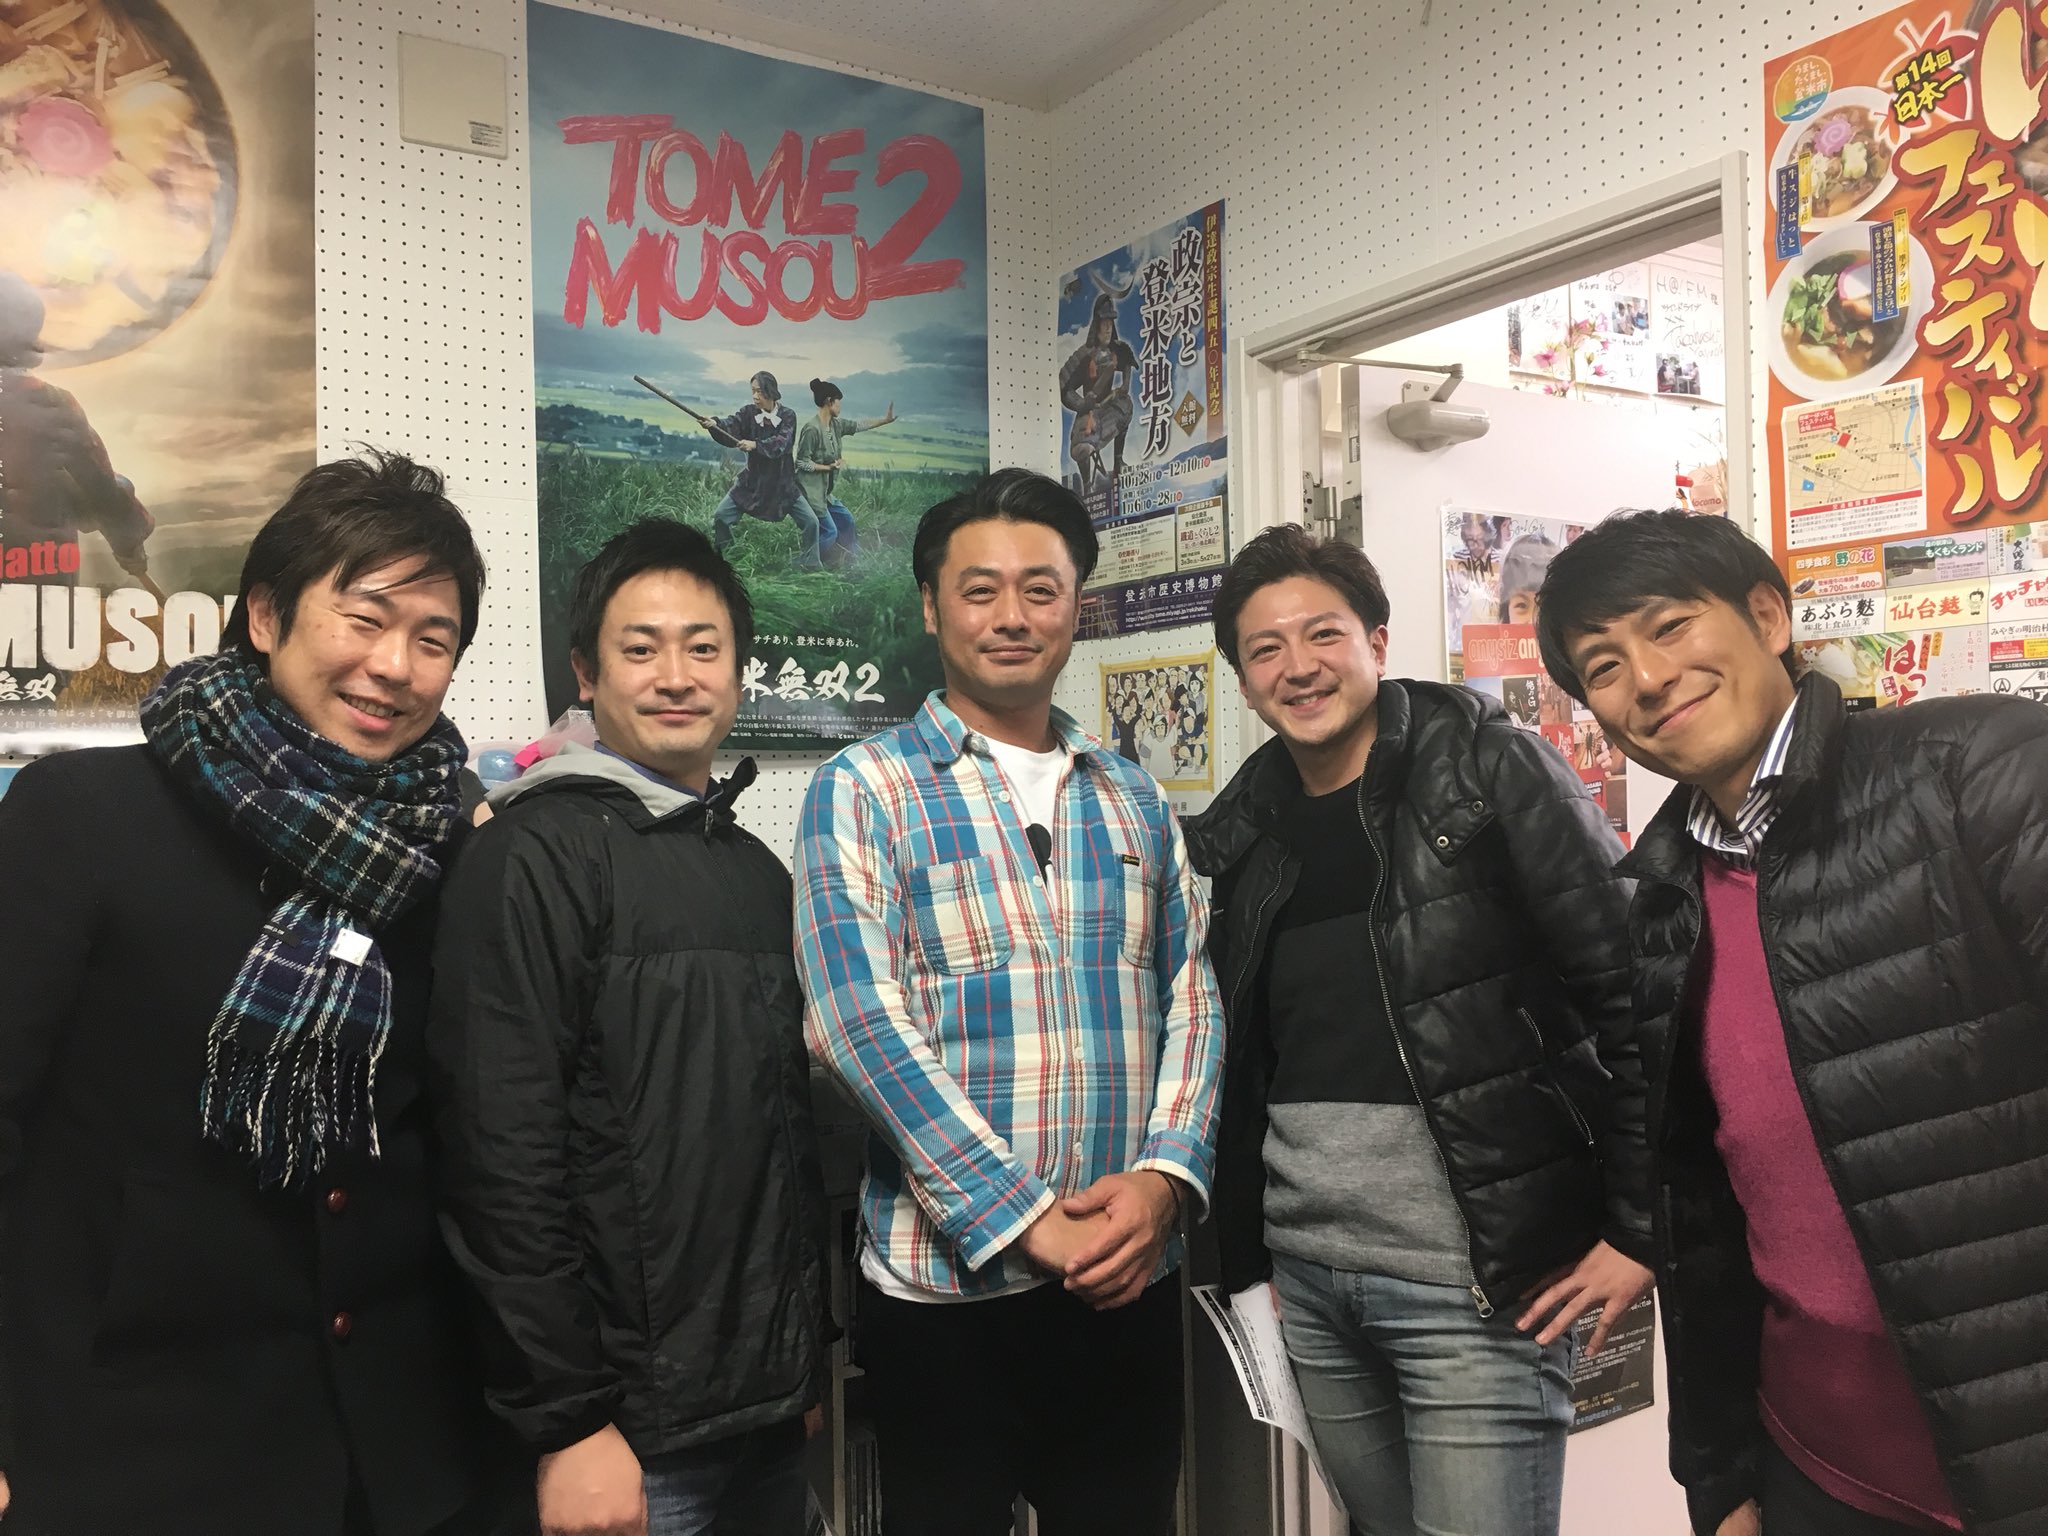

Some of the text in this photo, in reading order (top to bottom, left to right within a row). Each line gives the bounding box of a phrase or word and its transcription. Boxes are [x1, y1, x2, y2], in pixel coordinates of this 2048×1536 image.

[1895, 49, 1952, 91] 第14回
[1895, 73, 1964, 122] 日本一
[556, 114, 865, 235] TOME
[1788, 168, 1798, 248] 牛スジはっと
[564, 134, 966, 335] MUSOU 2
[1171, 228, 1202, 364] 政宗と
[1900, 130, 2043, 514] フェスティバル
[1140, 259, 1172, 458] 登米地方
[0, 541, 80, 579] atto
[1835, 547, 1875, 566] 野の花
[1926, 541, 1984, 558] もくもくランド
[1125, 574, 1222, 603] 登米市歴史博物館
[1890, 595, 1963, 621] 仙台麩
[1801, 598, 1875, 623] あぶら麩
[753, 635, 859, 648] サチあり、登米に幸あれ。
